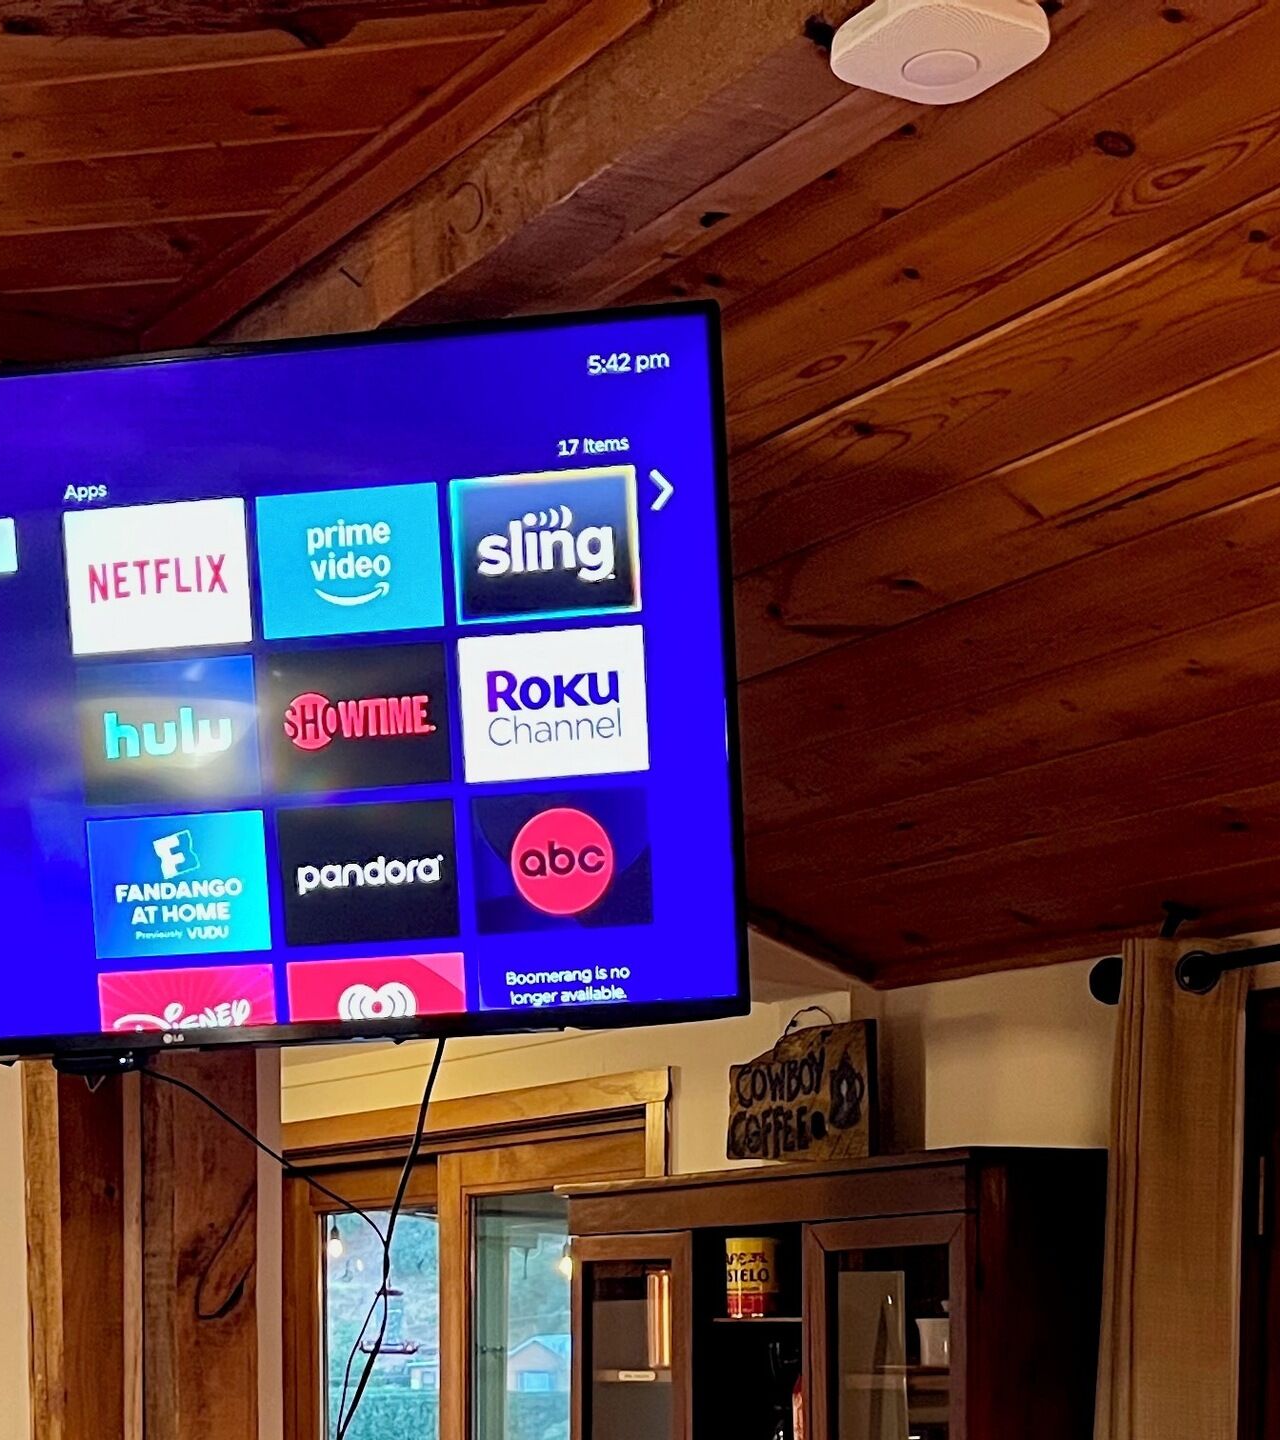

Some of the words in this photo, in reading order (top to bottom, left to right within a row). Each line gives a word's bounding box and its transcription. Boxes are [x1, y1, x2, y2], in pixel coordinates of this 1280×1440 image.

[587, 353, 631, 375] 5:42
[635, 352, 670, 373] pm
[557, 439, 579, 458] 17
[583, 437, 630, 455] Items
[64, 482, 107, 501] Apps
[306, 518, 391, 555] prime
[477, 510, 615, 582] sling
[87, 553, 229, 604] NETFLIX
[310, 551, 391, 582] video
[486, 669, 620, 713] Roku
[103, 706, 232, 760] hulu
[488, 707, 622, 747] Channel
[519, 839, 606, 878] abc
[115, 877, 244, 904] FANDANGO
[297, 856, 442, 896] pandora
[131, 905, 159, 925] AT
[162, 901, 231, 923] HOME
[135, 929, 183, 941] Previously
[186, 925, 230, 940] VUDU
[505, 967, 593, 985] Boomerang
[595, 965, 608, 980] is
[610, 966, 631, 980] no
[510, 990, 558, 1008] longer
[560, 984, 628, 1003] available.
[736, 1046, 826, 1109] COWBOY
